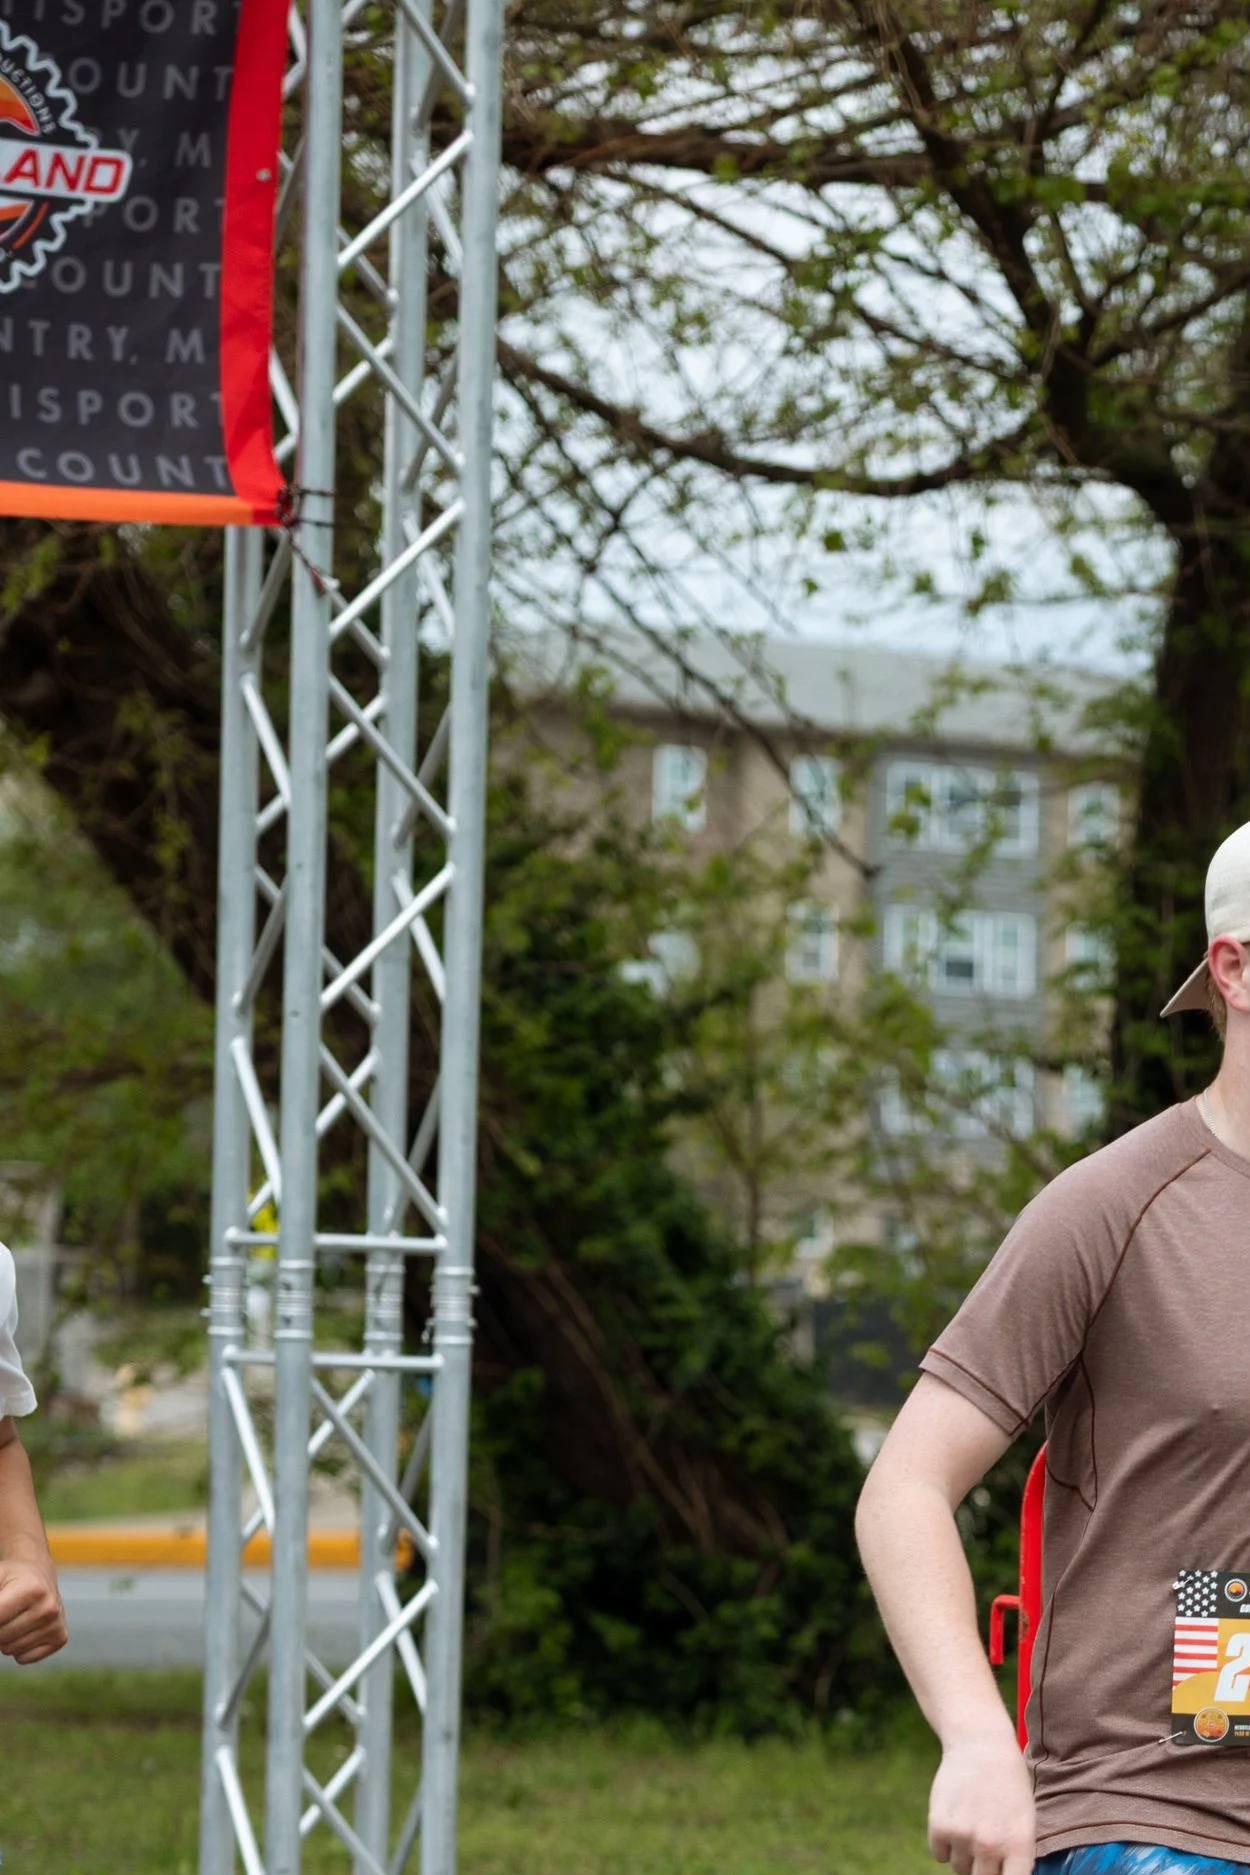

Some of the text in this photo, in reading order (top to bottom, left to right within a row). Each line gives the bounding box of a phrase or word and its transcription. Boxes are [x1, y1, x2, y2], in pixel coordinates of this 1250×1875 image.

[0, 53, 56, 134] UCTIONS
[40, 52, 235, 101] OUNT
[175, 131, 213, 169] M
[23, 255, 221, 299] OUNT
[165, 328, 206, 365] M
[15, 446, 229, 489] COUNT
